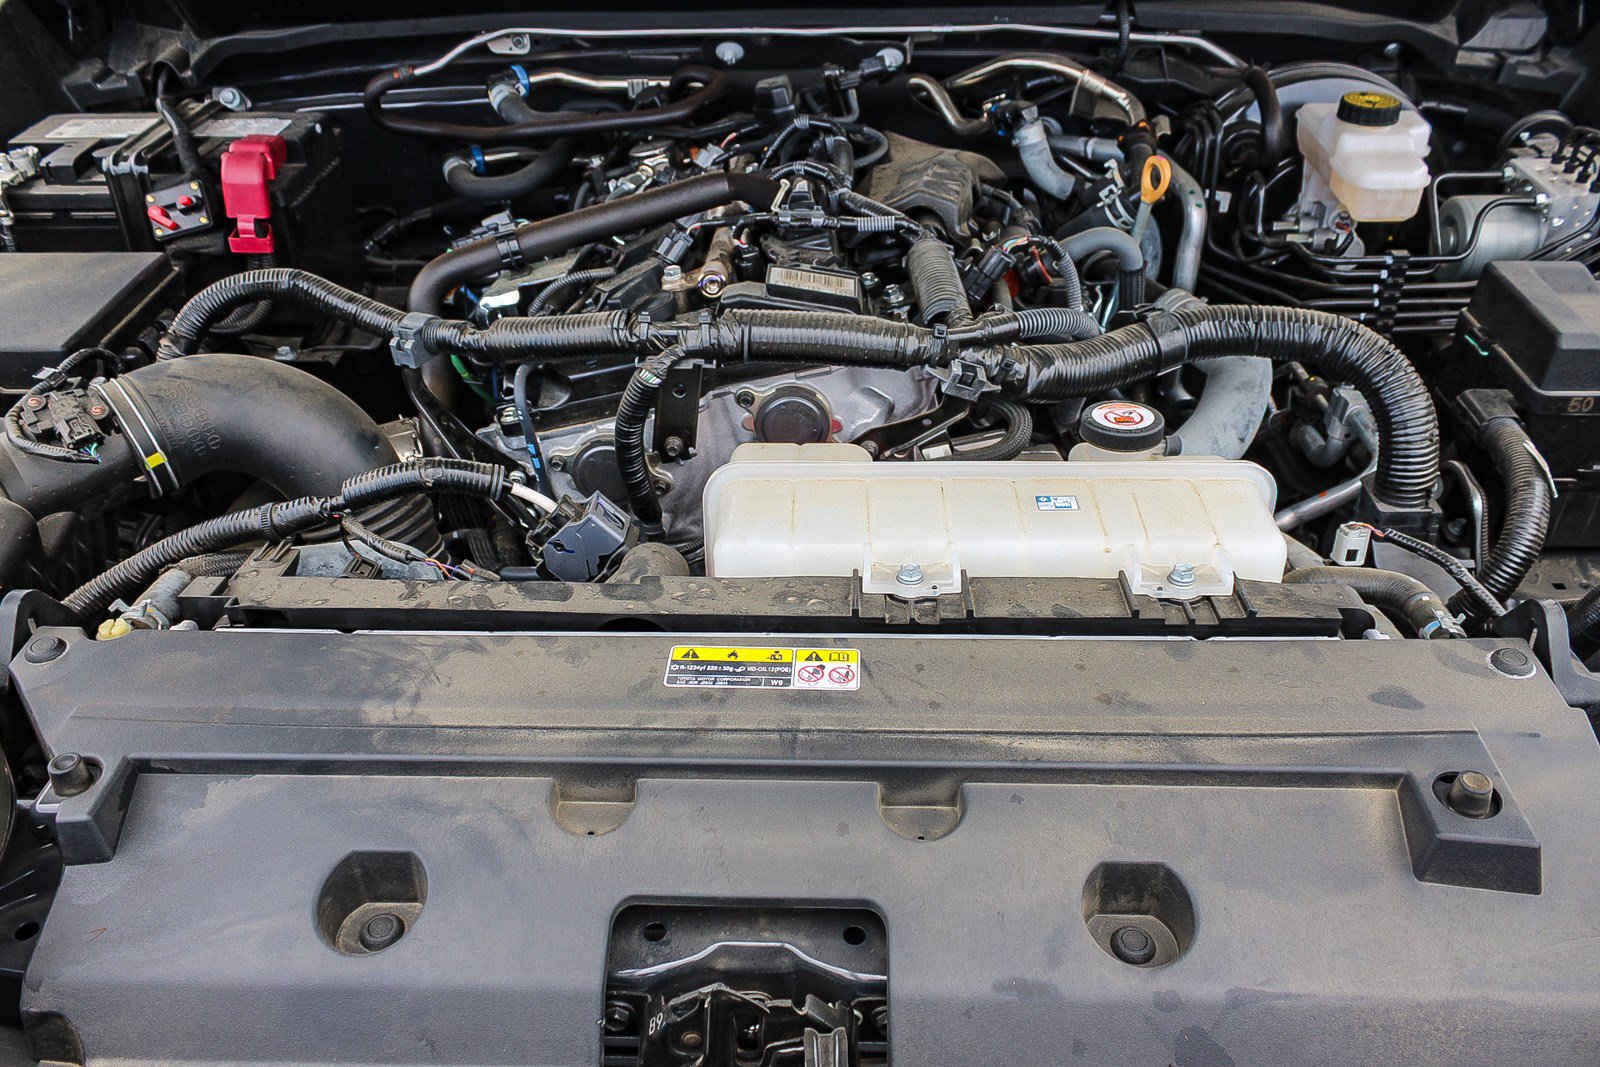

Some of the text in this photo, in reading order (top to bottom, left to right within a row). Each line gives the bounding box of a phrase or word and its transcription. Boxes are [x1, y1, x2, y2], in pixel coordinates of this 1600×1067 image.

[1567, 396, 1595, 413] 50
[679, 664, 706, 672] R-1234yf
[648, 1012, 663, 1036] B9
